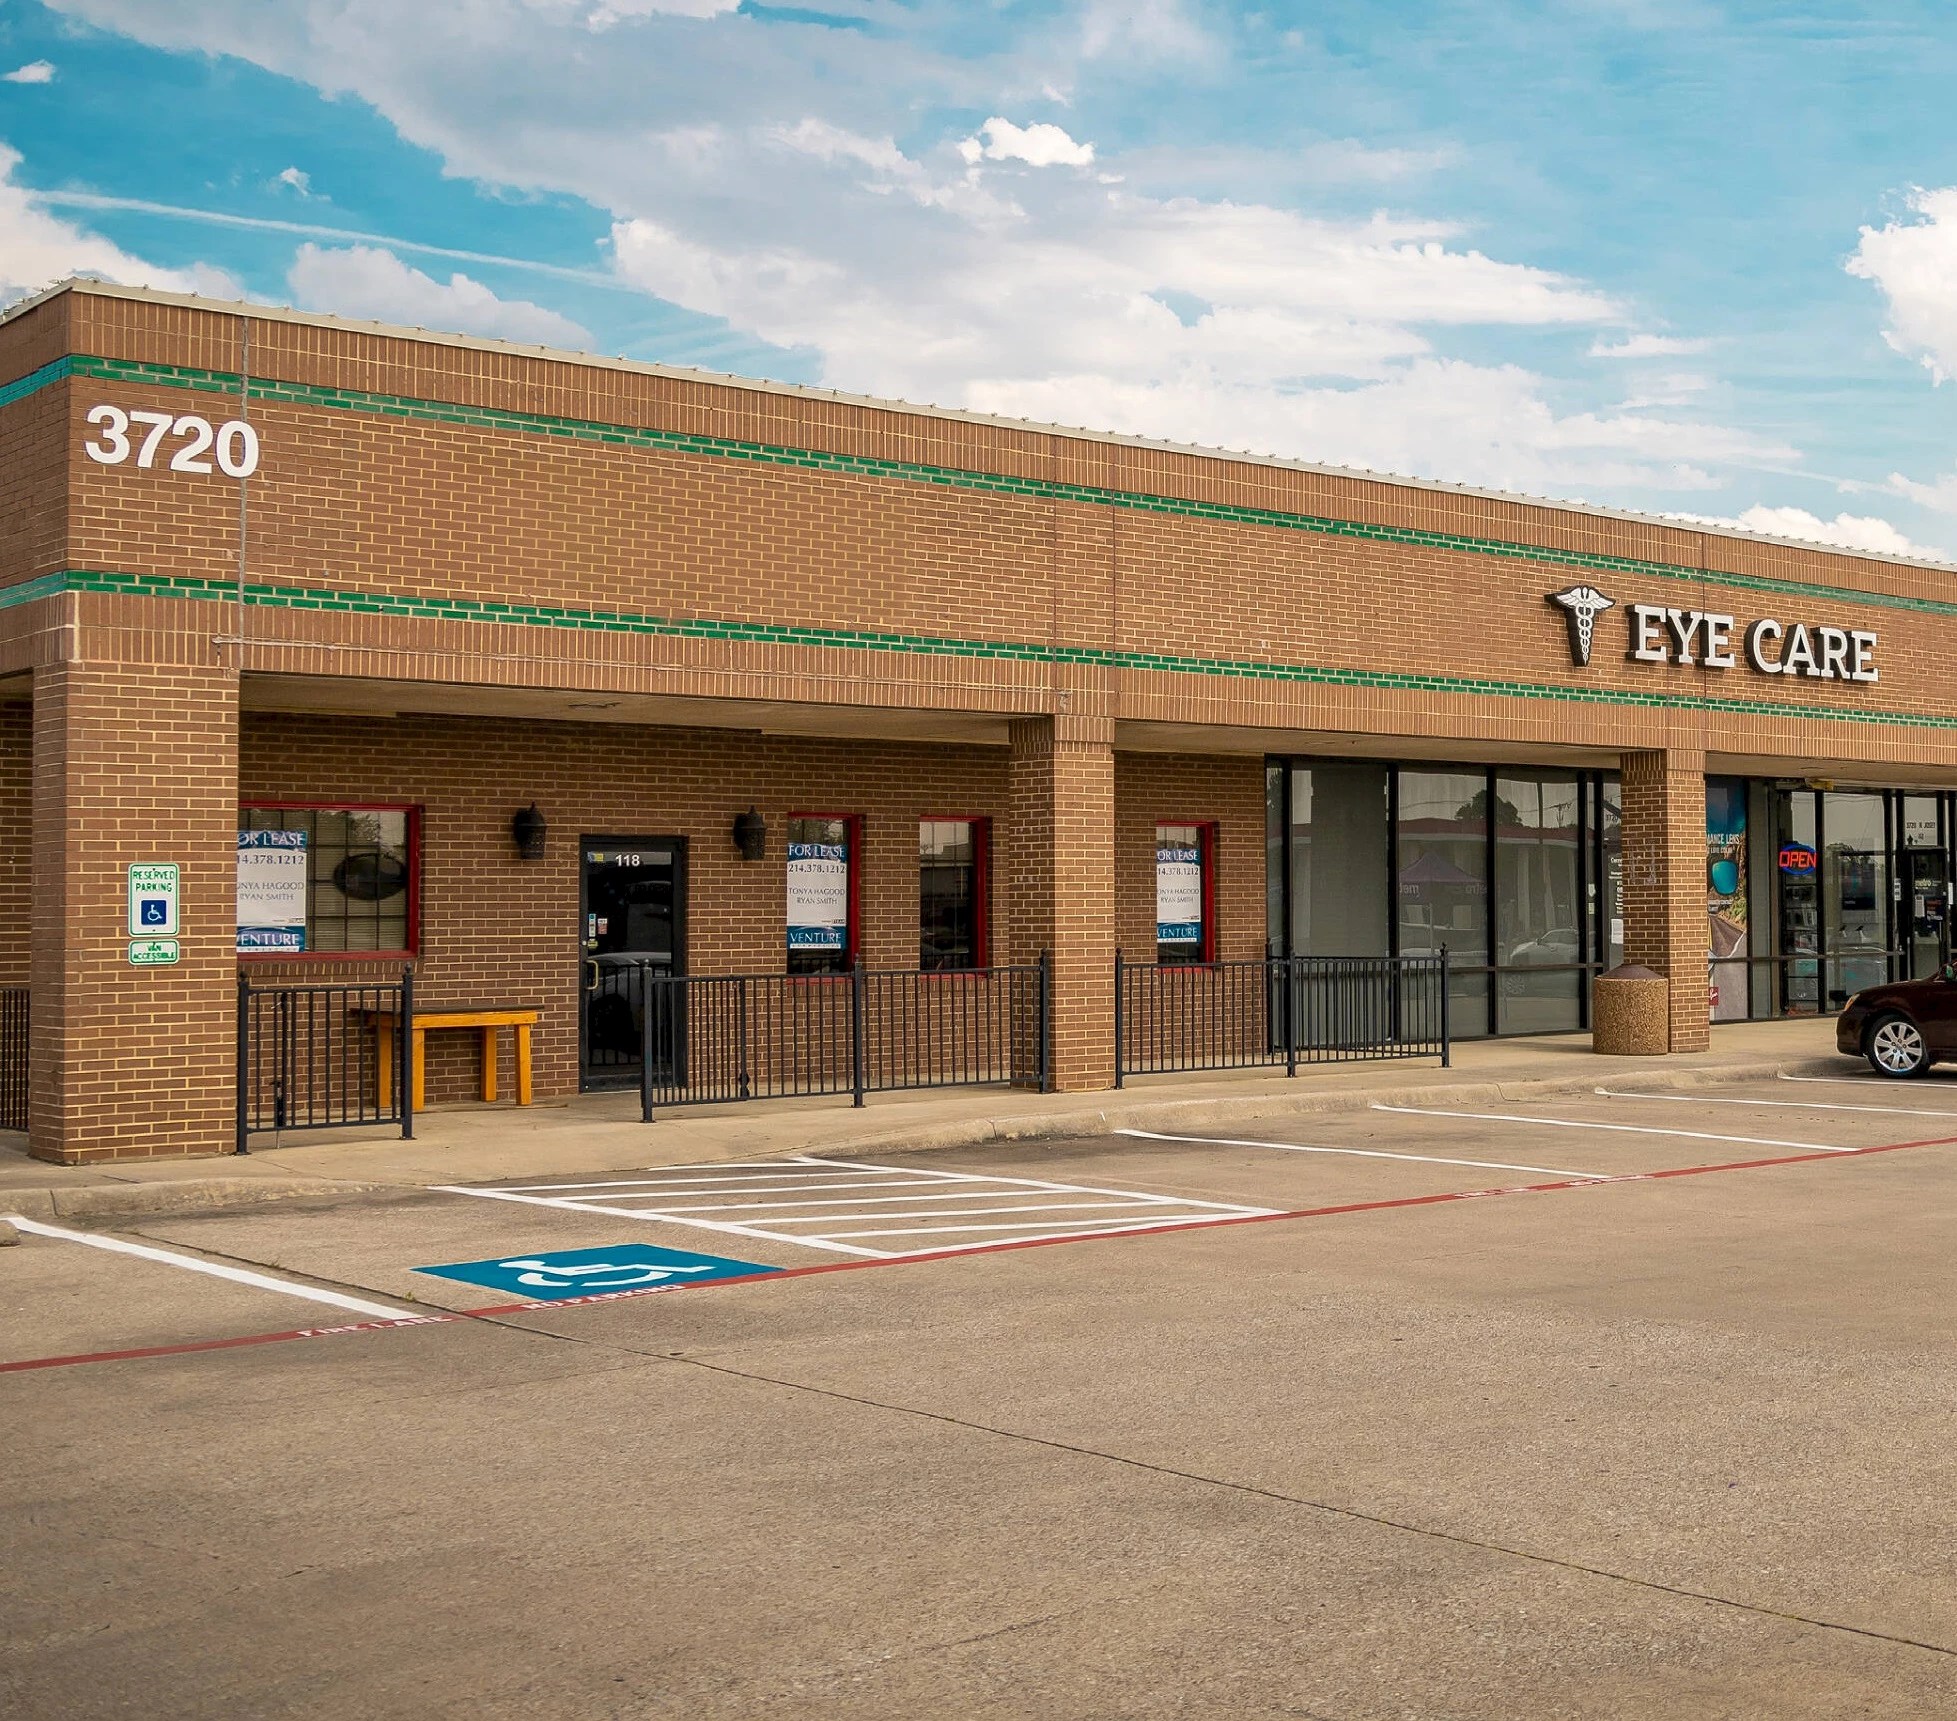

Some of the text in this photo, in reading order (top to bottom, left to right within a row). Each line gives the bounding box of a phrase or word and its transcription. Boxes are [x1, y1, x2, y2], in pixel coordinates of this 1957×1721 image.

[85, 404, 260, 478] 3720
[1627, 604, 1879, 682] EYE CARE
[238, 832, 304, 846] OR LEASE
[788, 844, 845, 857] FOR LEASE
[1157, 850, 1198, 861] OR LEASE
[237, 854, 304, 865] 14.378.1212
[615, 854, 640, 867] 118
[1778, 851, 1817, 868] OPEN
[788, 863, 845, 874] 214.378.1212
[1158, 867, 1199, 876] 14.378.1212
[132, 870, 175, 880] RESERVED
[135, 882, 173, 893] PARKING
[237, 882, 305, 891] NYA HAGOOD
[788, 887, 813, 895] TONYA
[240, 893, 294, 901] RYAN SMITH
[796, 897, 838, 905] RYAN SMITH
[790, 932, 842, 943] VENTURE
[133, 951, 176, 960] ACCESSIBLE
[521, 1284, 686, 1310] NO PARKING
[297, 1315, 453, 1337] FIRE LANE
